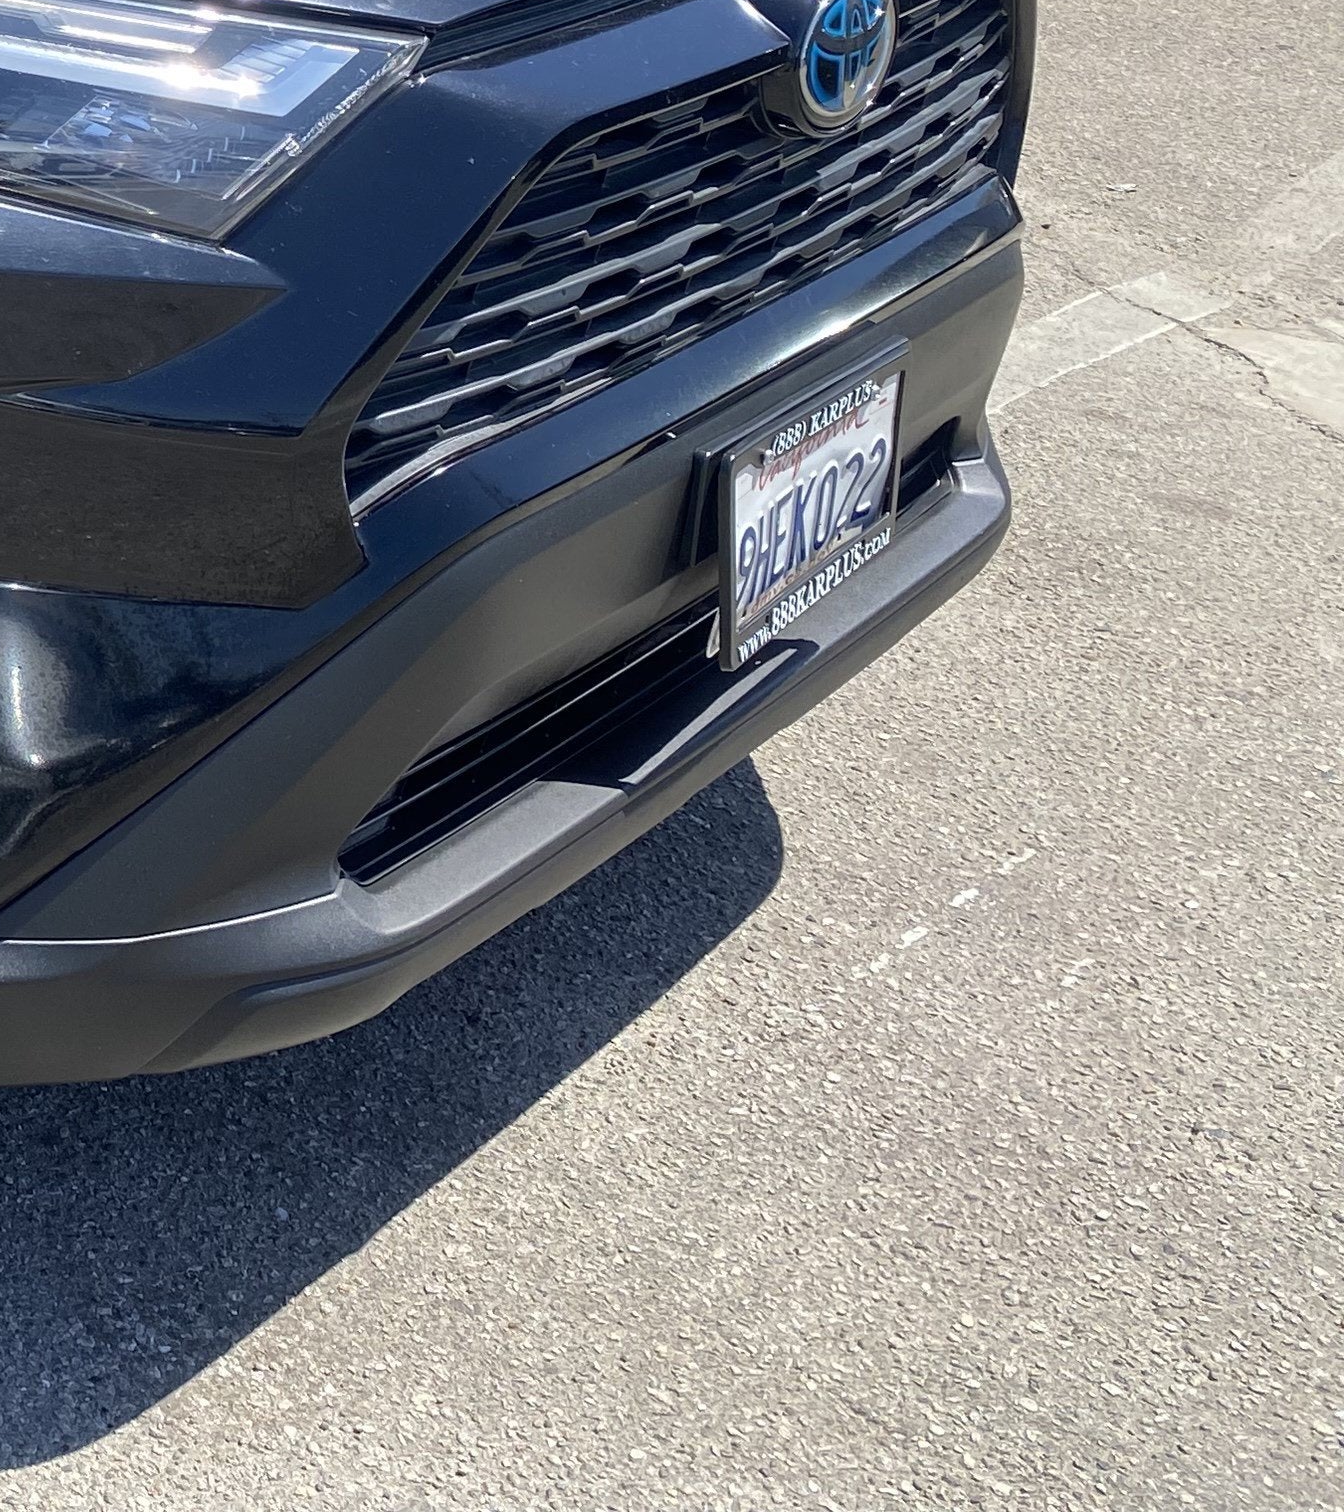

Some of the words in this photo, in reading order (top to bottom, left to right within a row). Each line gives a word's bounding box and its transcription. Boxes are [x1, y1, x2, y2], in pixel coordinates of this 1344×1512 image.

[772, 420, 807, 456] (888)
[808, 379, 874, 437] KARPLUS
[736, 436, 888, 605] 9HEK022
